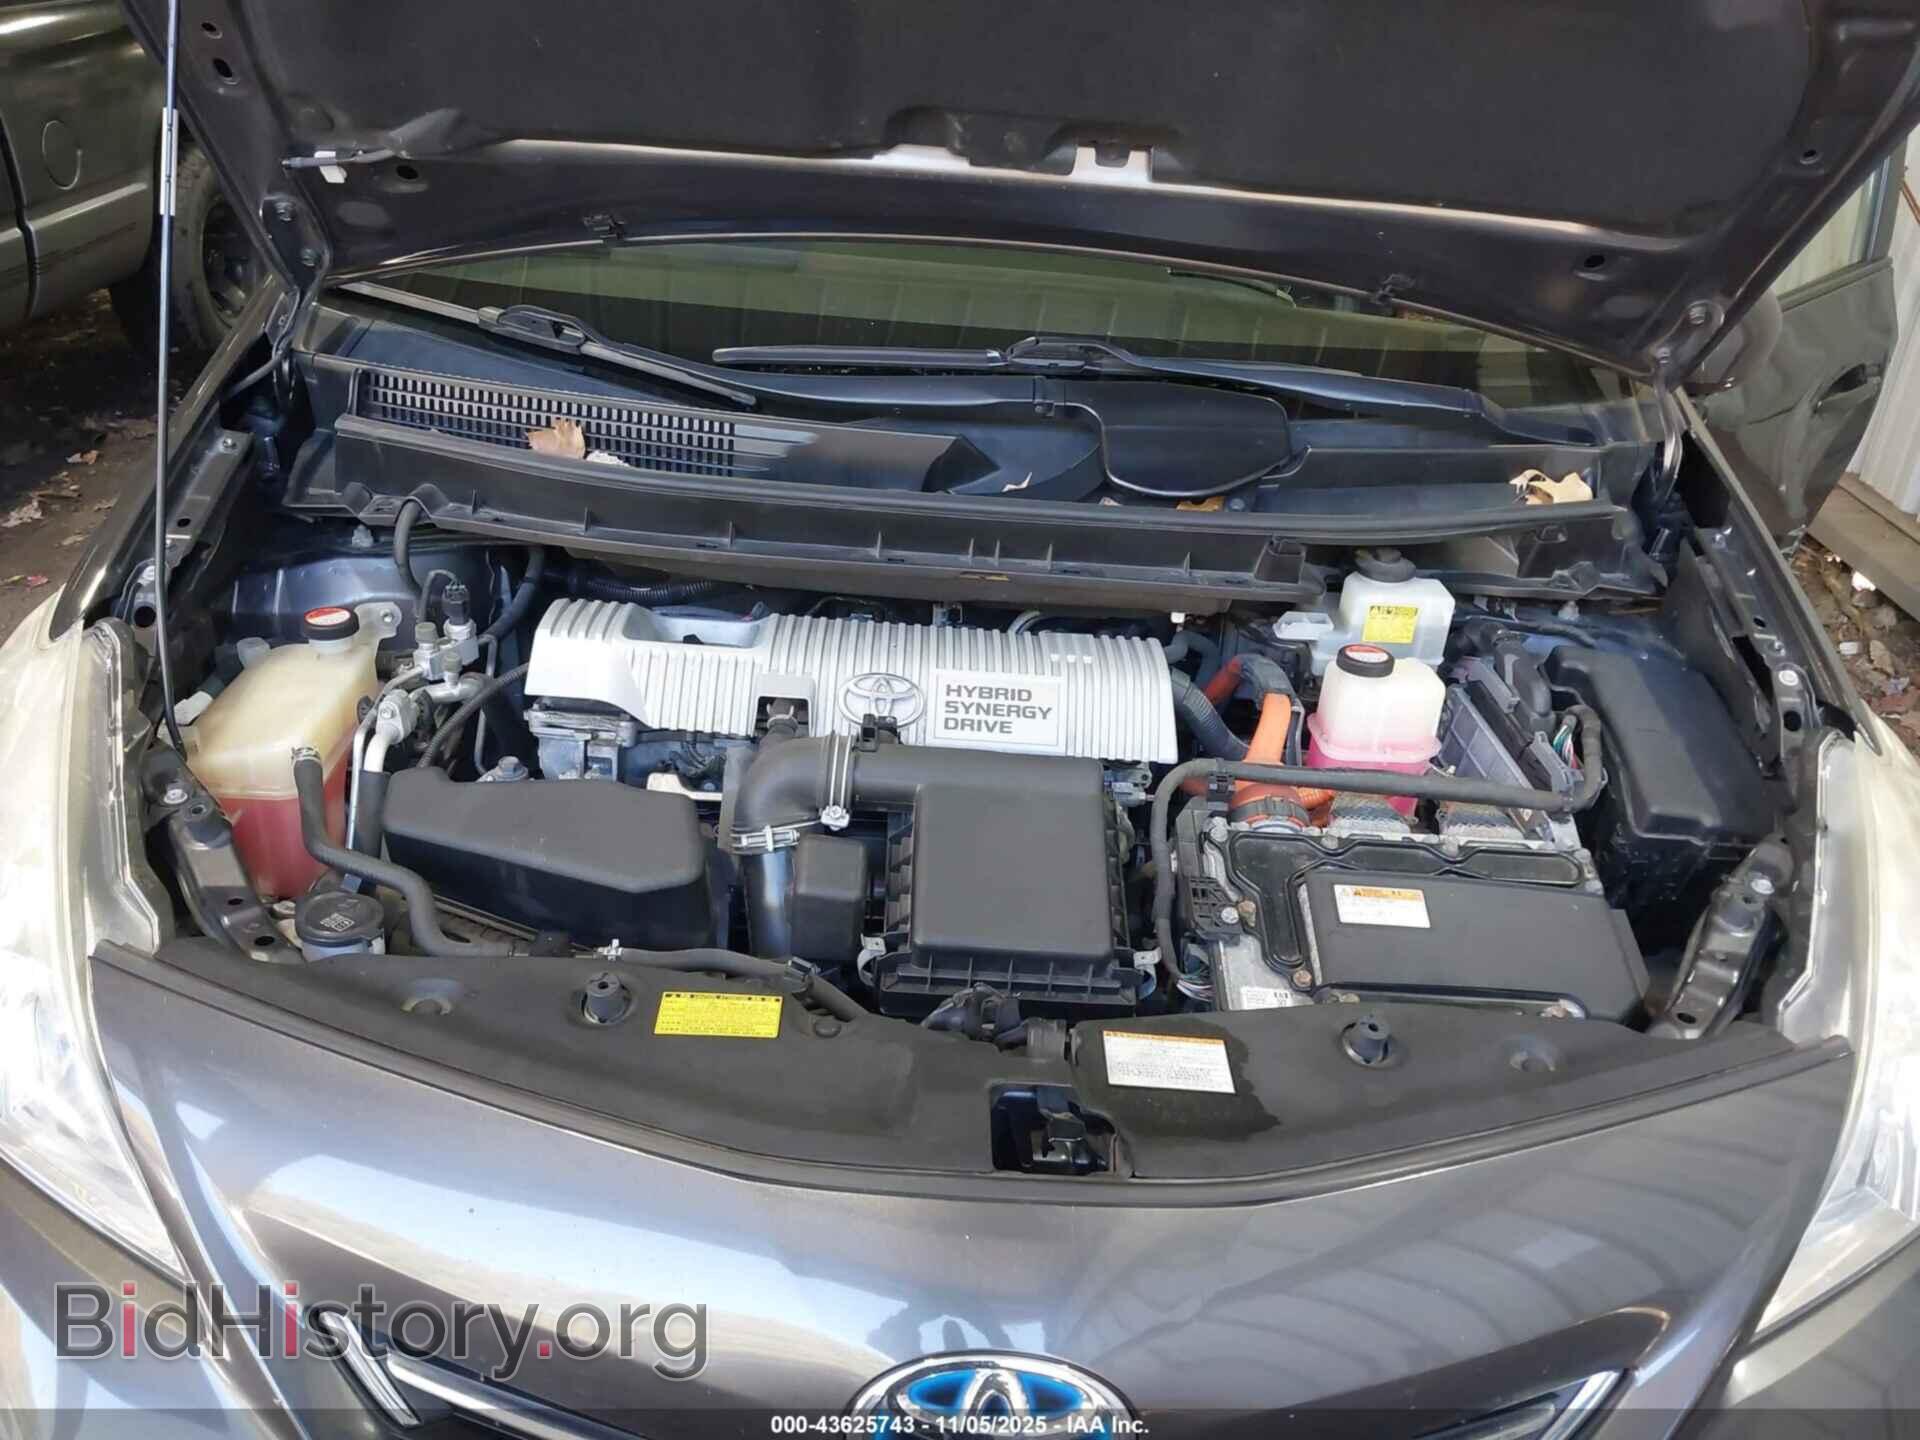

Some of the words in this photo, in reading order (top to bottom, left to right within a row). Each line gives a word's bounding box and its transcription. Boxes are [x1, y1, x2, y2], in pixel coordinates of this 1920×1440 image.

[945, 685, 1032, 702] HYBRID
[945, 702, 1052, 720] SYNERGY
[944, 718, 1013, 734] DRIVE
